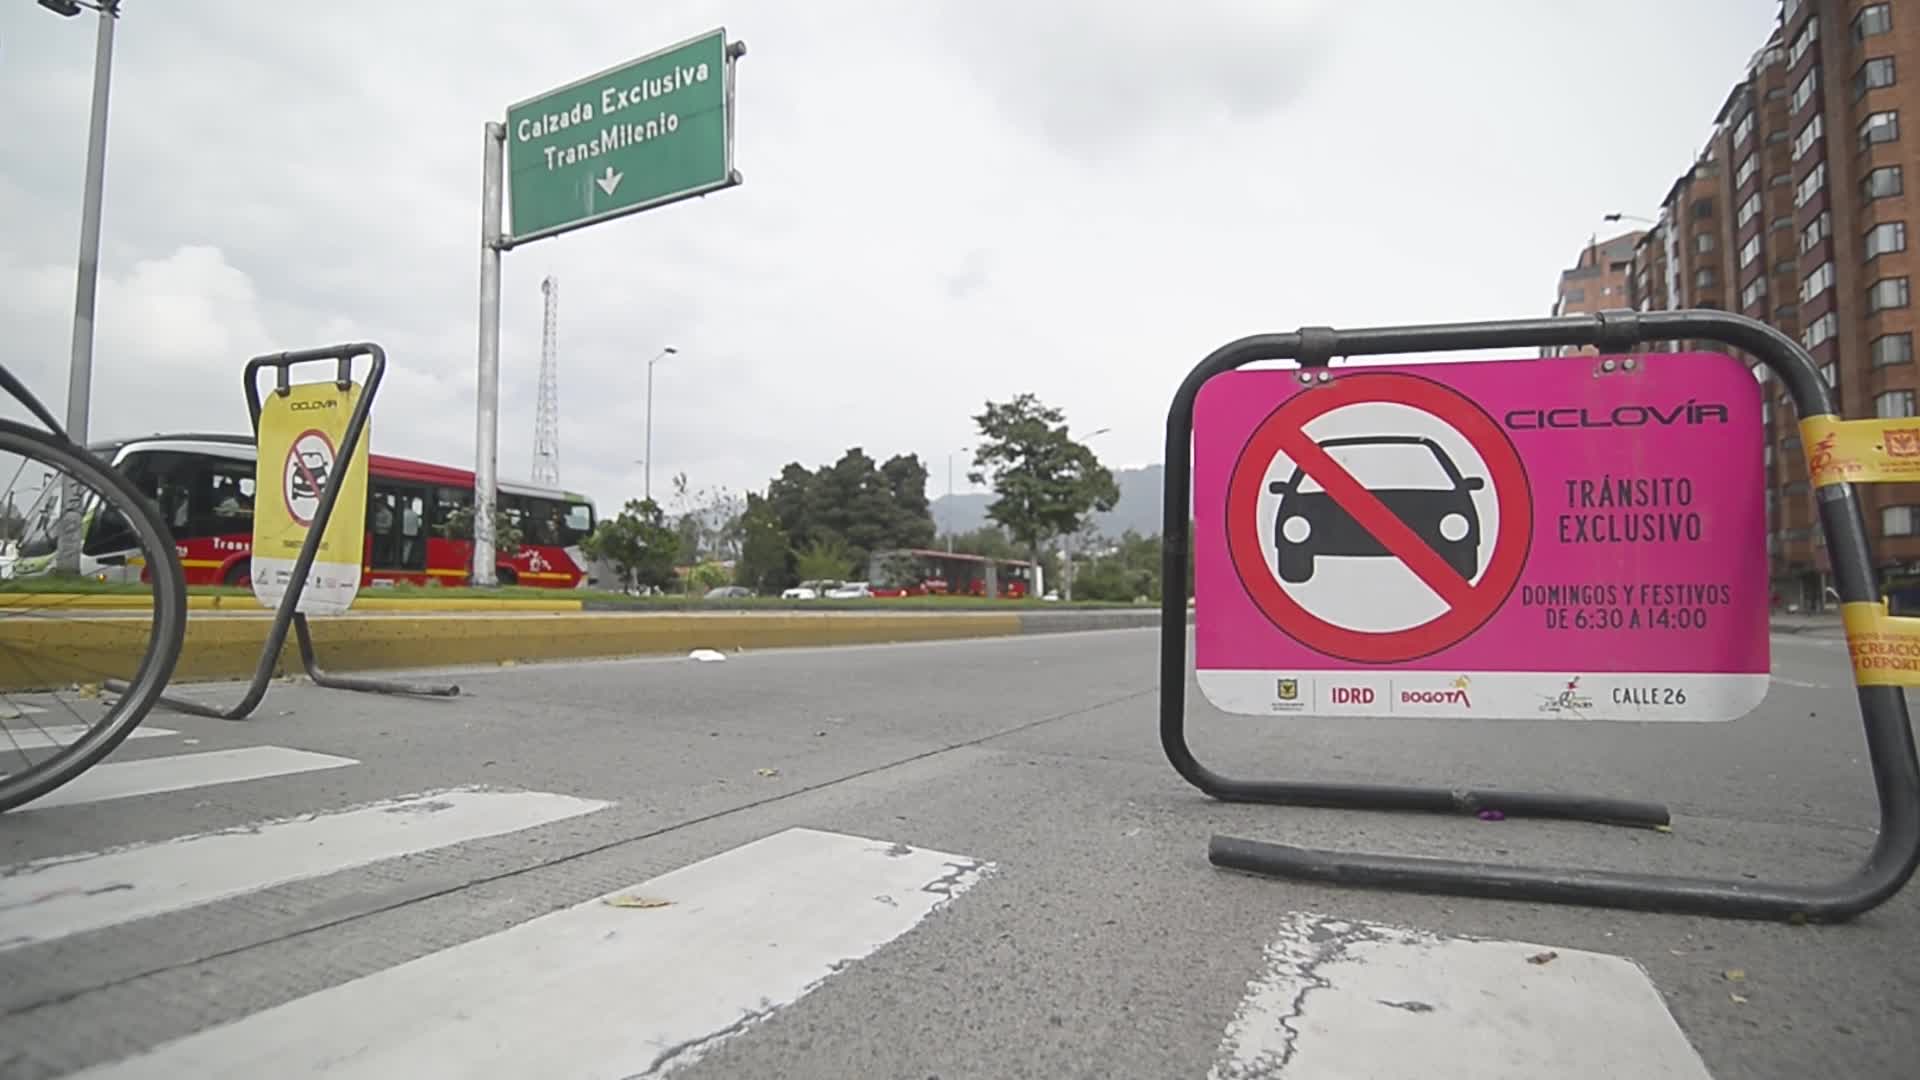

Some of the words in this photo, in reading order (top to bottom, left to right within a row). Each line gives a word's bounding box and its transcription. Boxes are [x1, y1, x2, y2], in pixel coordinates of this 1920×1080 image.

[517, 101, 593, 141] Calzada
[602, 62, 709, 115] Exclusiva
[544, 112, 679, 170] TransMilenio
[1566, 474, 1692, 508] TRÁNSITO
[1559, 513, 1702, 543] EXCLUSIVO
[1522, 585, 1617, 606] DOMINGOS
[1623, 585, 1634, 605] Y
[1641, 584, 1730, 605] FESTIVOS
[1546, 608, 1569, 629] DE
[1575, 608, 1623, 629] 6:30
[1629, 608, 1641, 629] A
[1648, 608, 1707, 629] 14:00
[1332, 688, 1375, 704] IDRD
[1612, 688, 1658, 704] CALLE
[1664, 688, 1687, 705] 26
